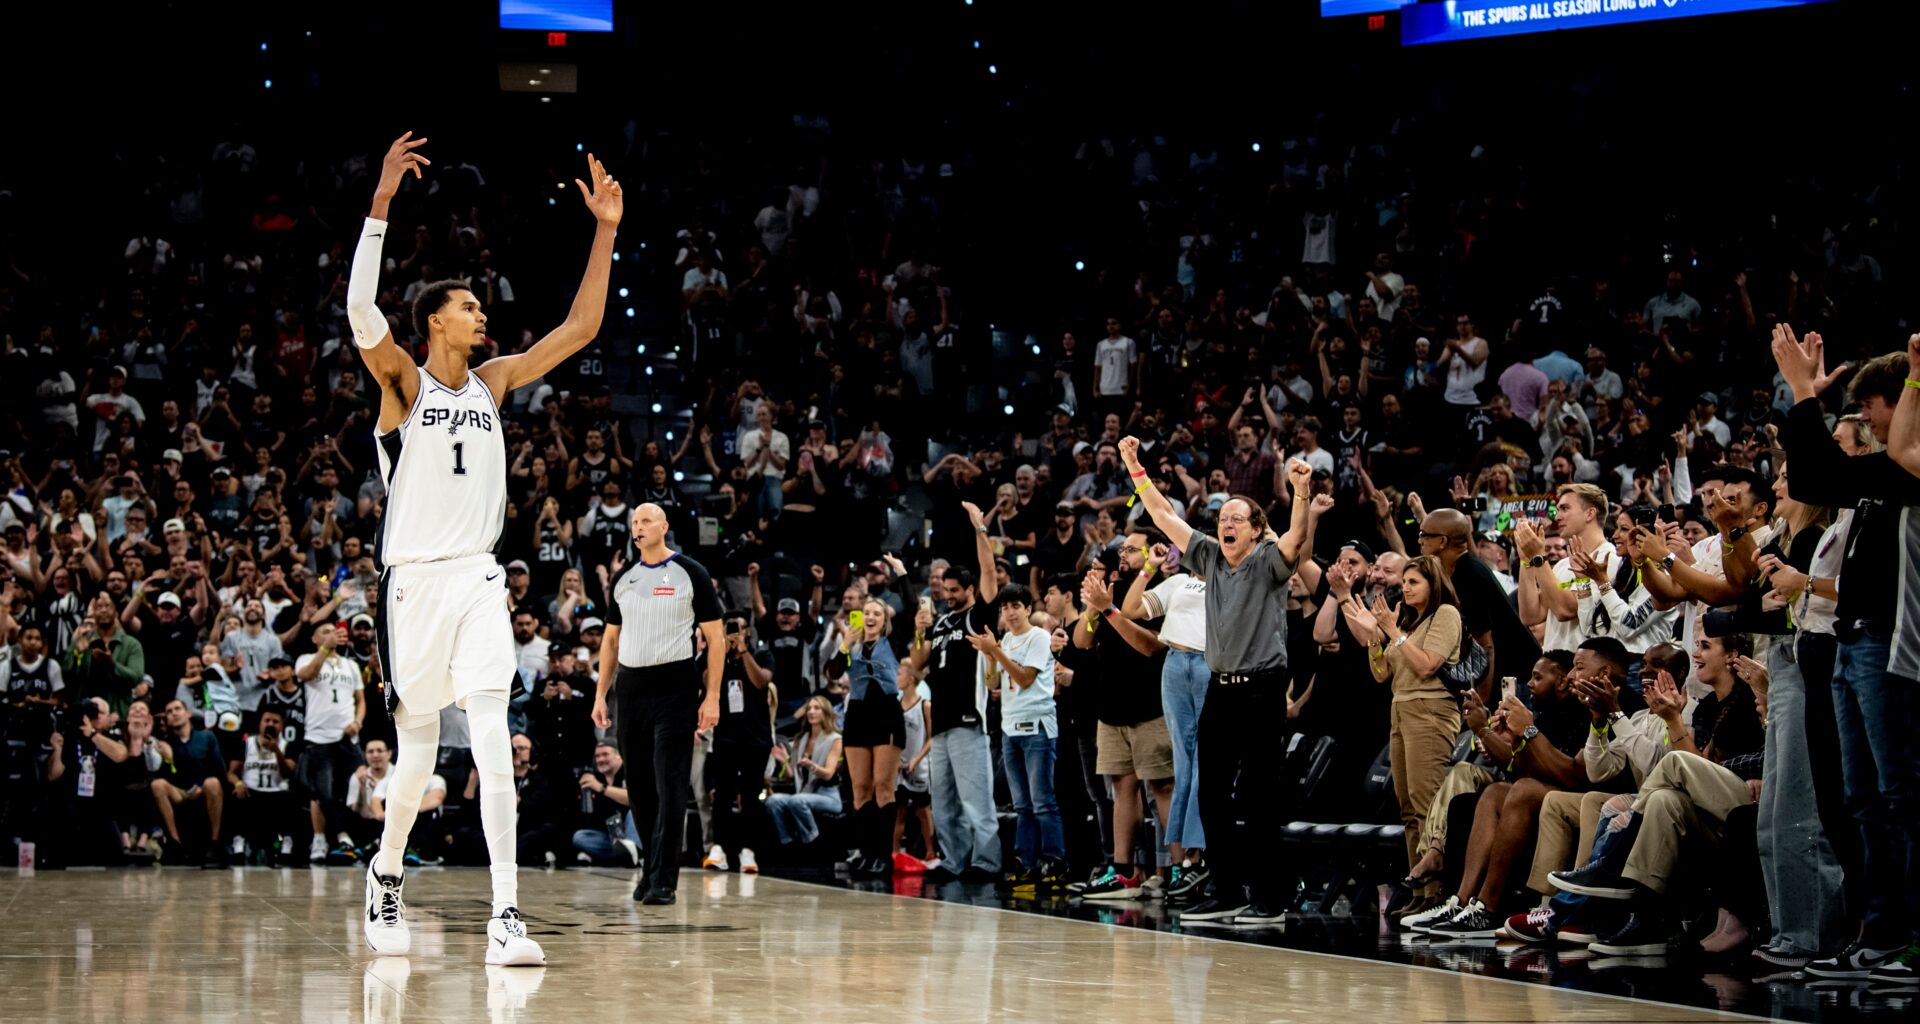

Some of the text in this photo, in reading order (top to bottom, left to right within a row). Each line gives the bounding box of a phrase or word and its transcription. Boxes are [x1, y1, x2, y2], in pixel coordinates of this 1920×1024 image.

[1462, 11, 1486, 28] THE
[1488, 5, 1528, 25] SPURS
[1530, 2, 1551, 20] ALL
[1553, 0, 1601, 18] SEASON
[579, 358, 604, 376] 20
[422, 407, 492, 434] SPURS
[452, 441, 467, 476] 1
[1501, 499, 1548, 513] AREA 210
[538, 541, 566, 562] 20
[938, 649, 947, 669] 1
[331, 689, 339, 704] 1
[257, 774, 273, 788] 11
